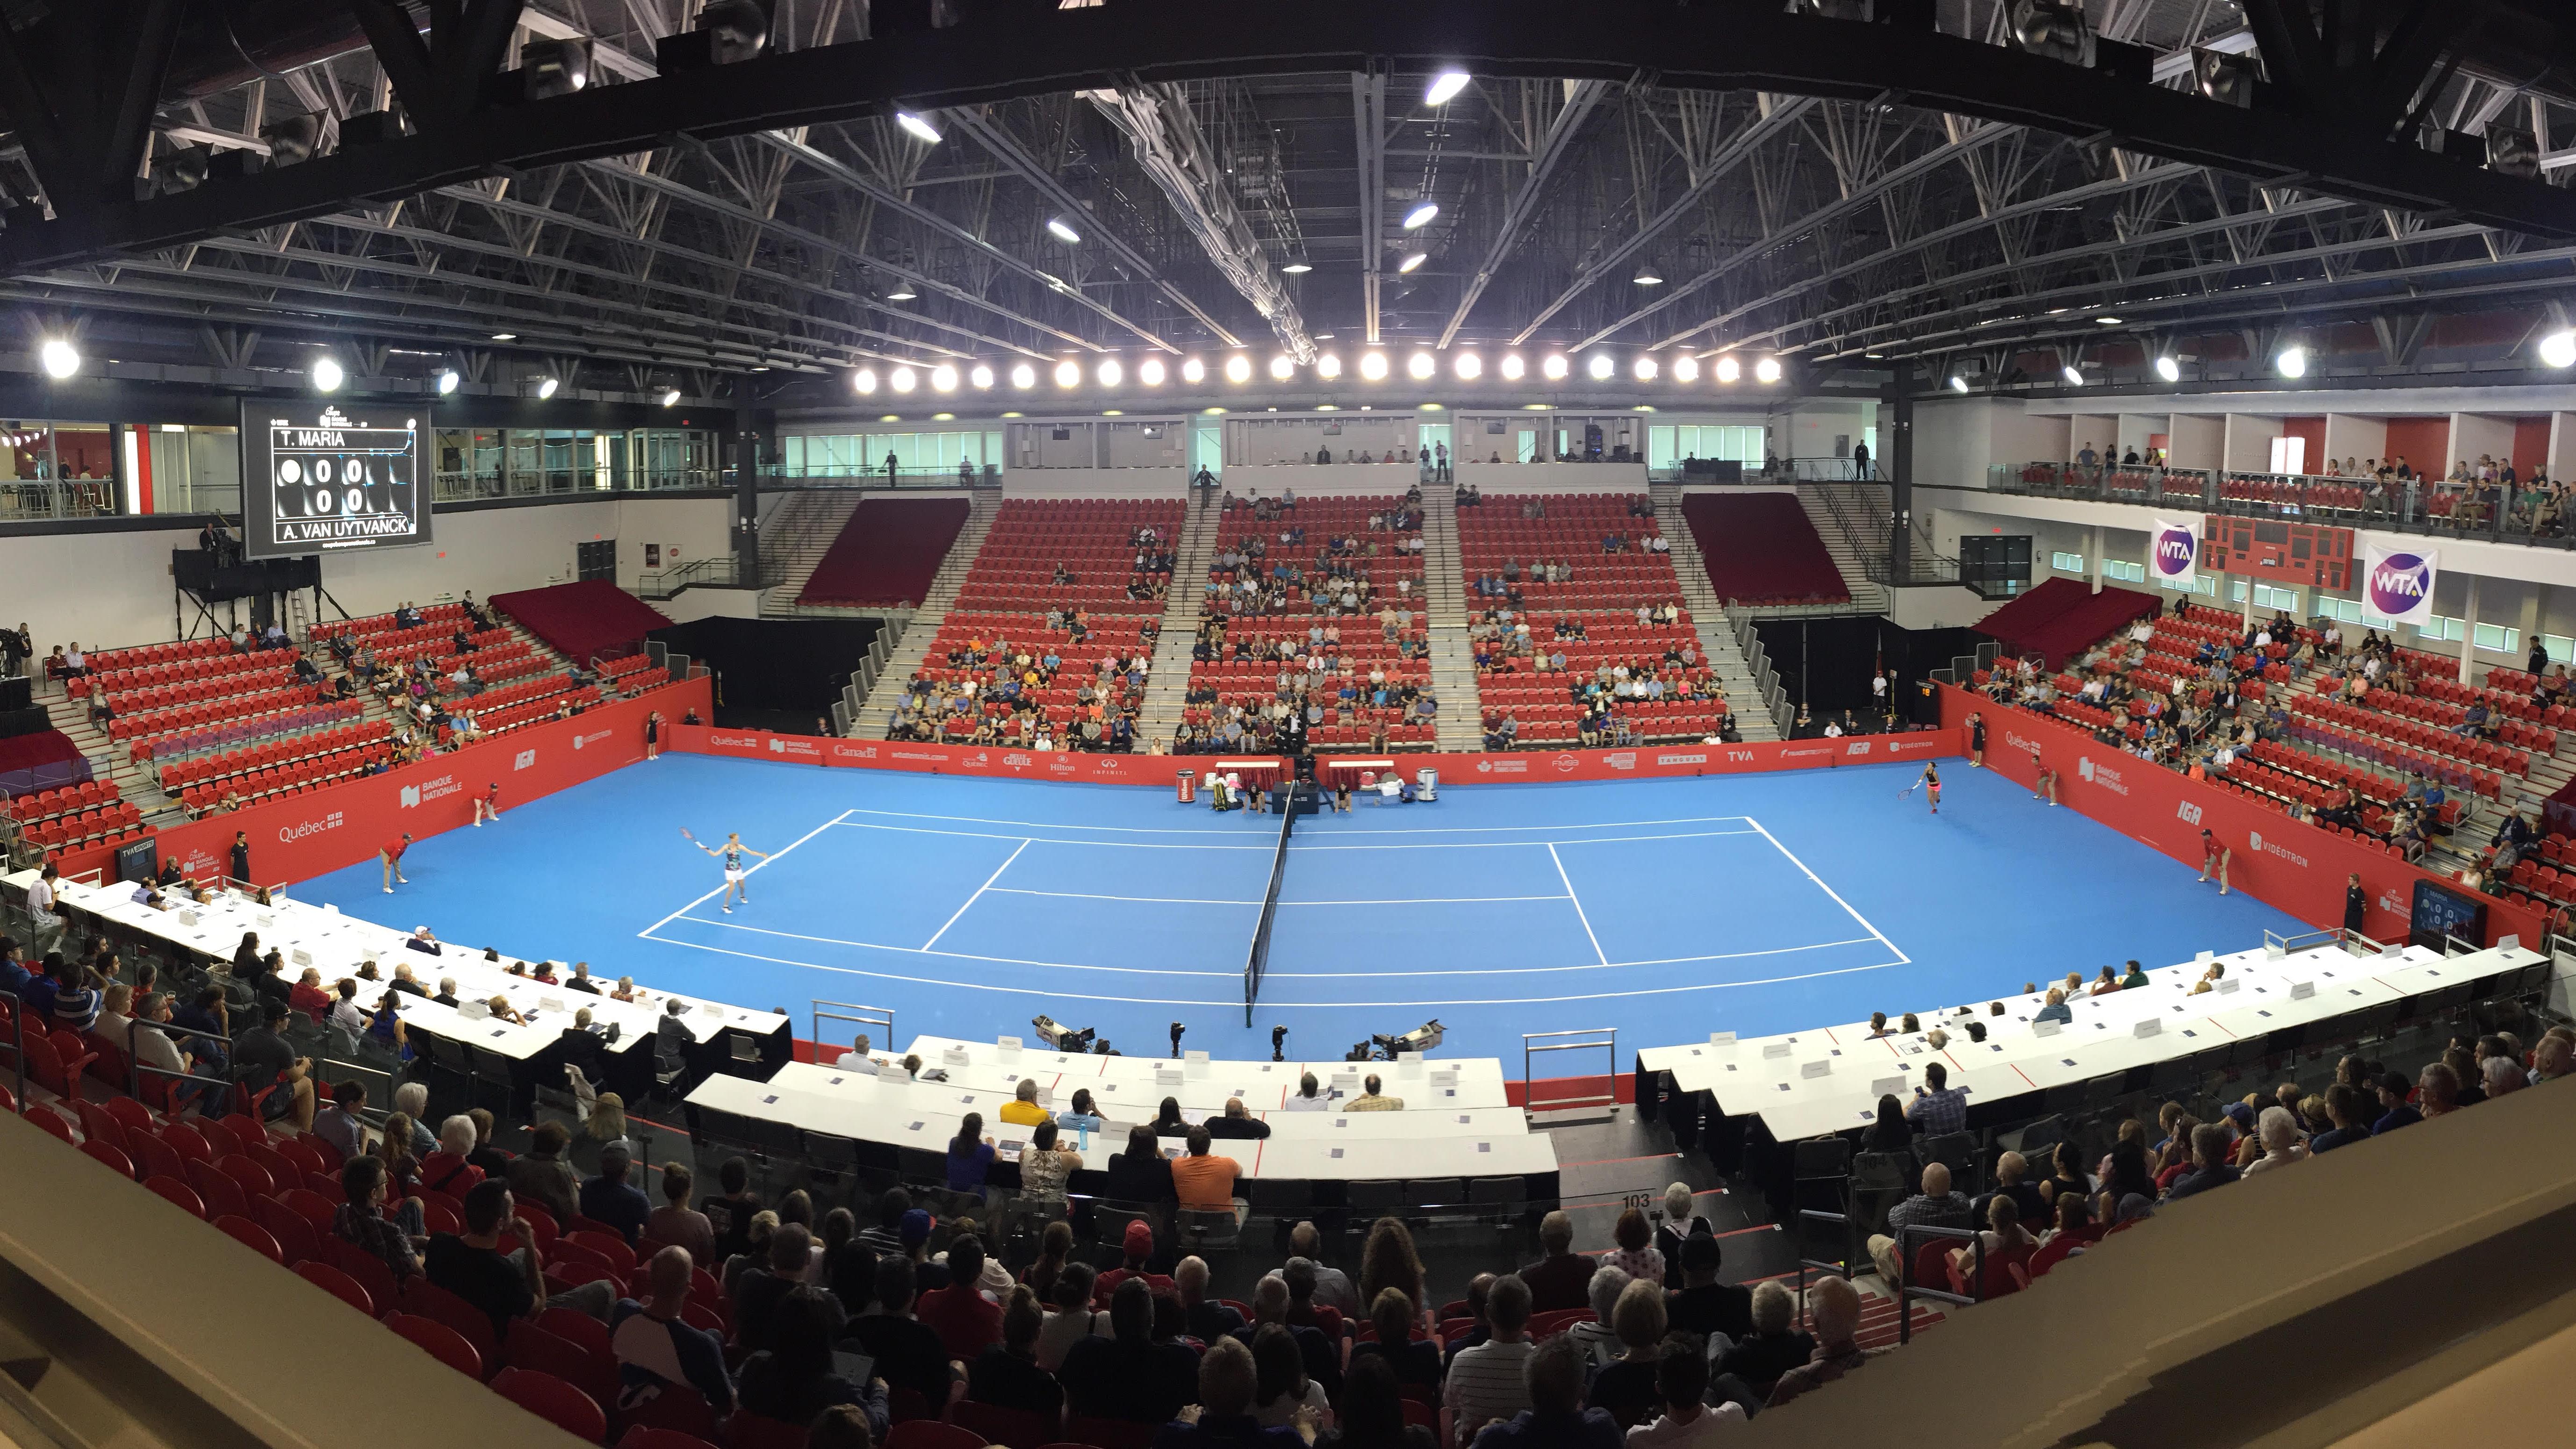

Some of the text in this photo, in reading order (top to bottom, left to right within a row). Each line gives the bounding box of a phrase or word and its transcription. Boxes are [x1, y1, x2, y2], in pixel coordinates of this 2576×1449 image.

[281, 430, 345, 447] T. MARIA
[316, 459, 362, 483] 0 0
[317, 488, 362, 512] 0 0
[284, 518, 407, 540] A. VAN UYTVANCK
[2159, 540, 2191, 561] WTA
[2375, 570, 2424, 597] WTA
[710, 735, 744, 746] Québec
[1847, 742, 1871, 755] IGA
[2006, 731, 2030, 752] Québec
[513, 748, 536, 771] IGA
[834, 744, 877, 758] Canada
[1727, 750, 1754, 762] TVA
[423, 774, 453, 792] BANQUE
[423, 782, 462, 802] NATIONALE
[2177, 800, 2202, 826] IGA
[279, 820, 326, 843] Québec
[122, 840, 153, 857] TVA SPORTS
[189, 851, 205, 861] Coupe
[2263, 840, 2308, 868] VIDÉOTRON
[196, 856, 214, 865] BANQUE
[196, 859, 220, 870] NATIONALE
[2386, 889, 2403, 904] Coupe
[2430, 890, 2448, 903] MARIA
[2391, 907, 2411, 920] NATIONA
[2435, 904, 2454, 919] 0 0
[2434, 915, 2454, 930] 0 0
[1622, 1193, 1650, 1209] 103
